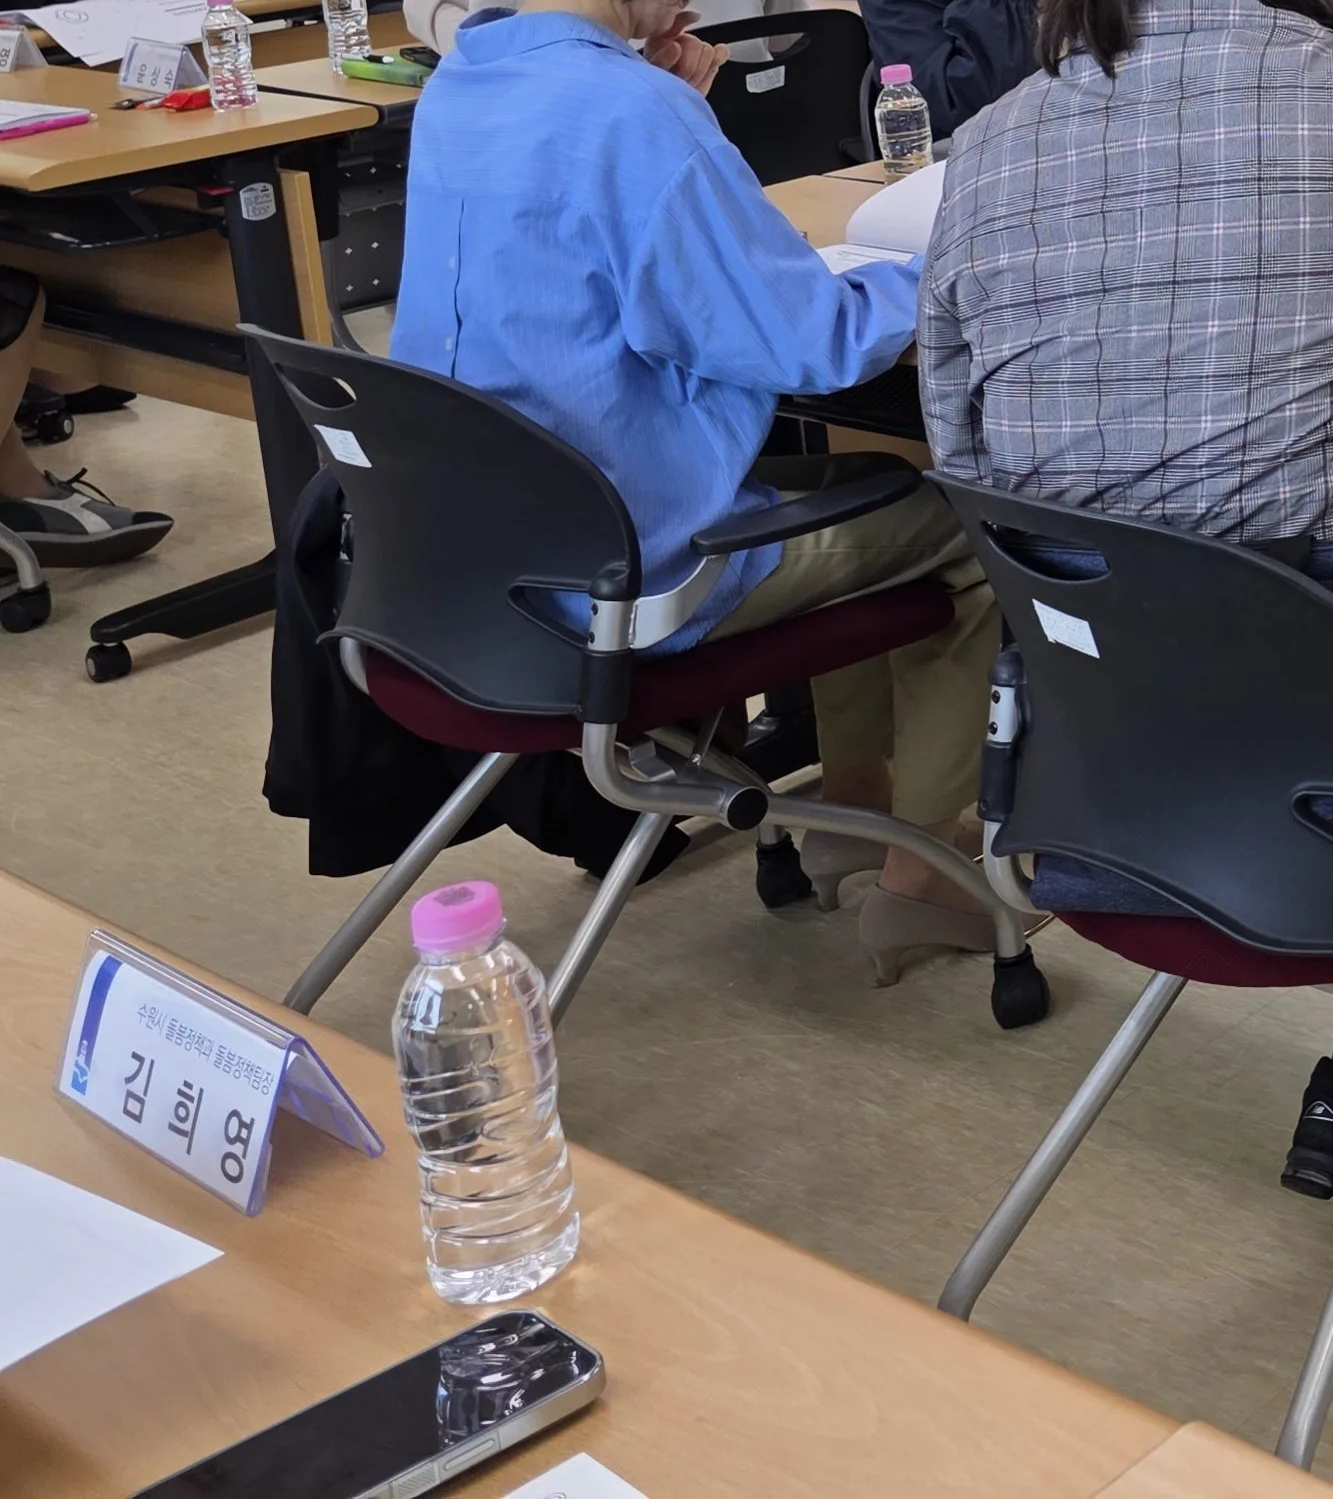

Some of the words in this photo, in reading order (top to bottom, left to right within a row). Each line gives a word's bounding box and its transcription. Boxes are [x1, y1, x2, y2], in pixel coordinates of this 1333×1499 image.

[137, 1003, 166, 1037] 수원시
[165, 1018, 216, 1062] 돌봄정책과
[213, 1044, 275, 1096] 돌봄정책팀장
[122, 1051, 256, 1184] 김희영
